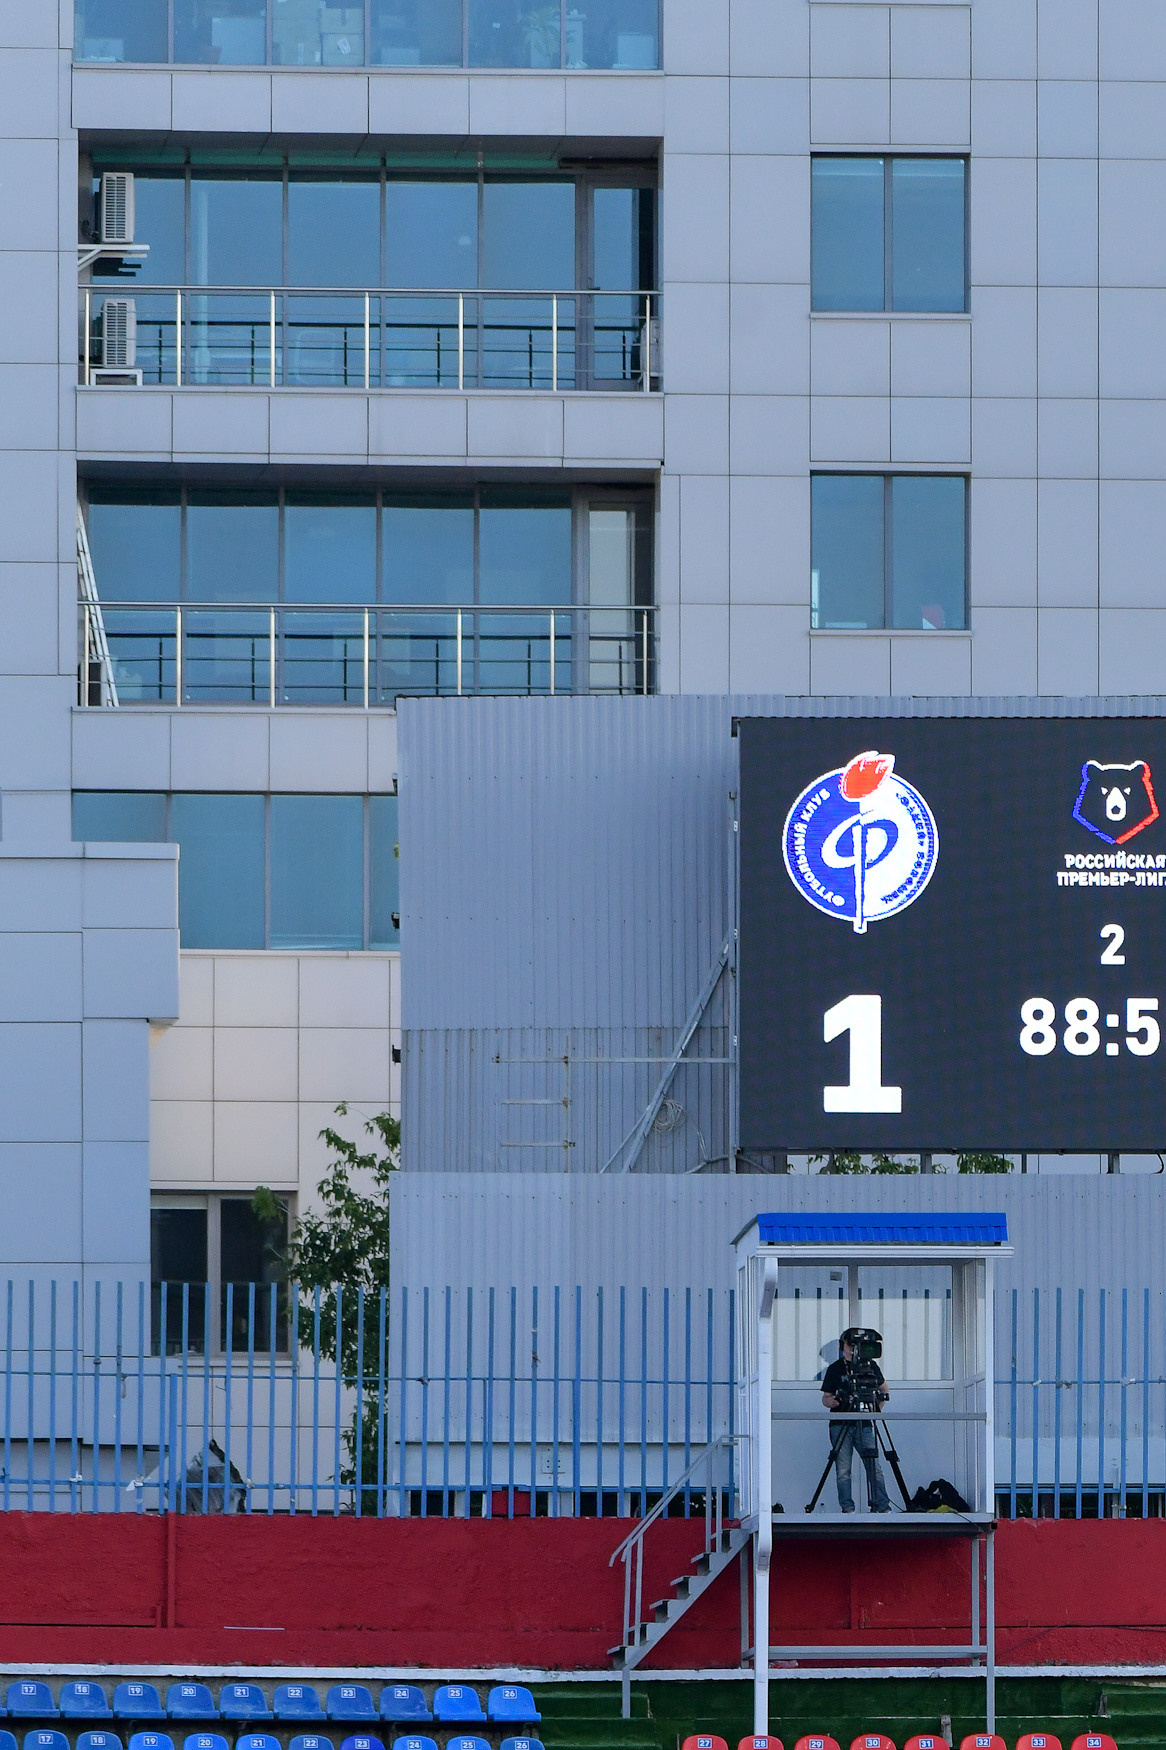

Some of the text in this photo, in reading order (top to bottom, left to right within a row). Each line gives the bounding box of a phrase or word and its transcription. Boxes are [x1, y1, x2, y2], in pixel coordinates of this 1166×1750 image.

[800, 788, 831, 823] КЛУБ
[1064, 851, 1166, 870] РОССИЙСКАЯ
[1101, 924, 1126, 965] 2
[824, 995, 902, 1114] 1
